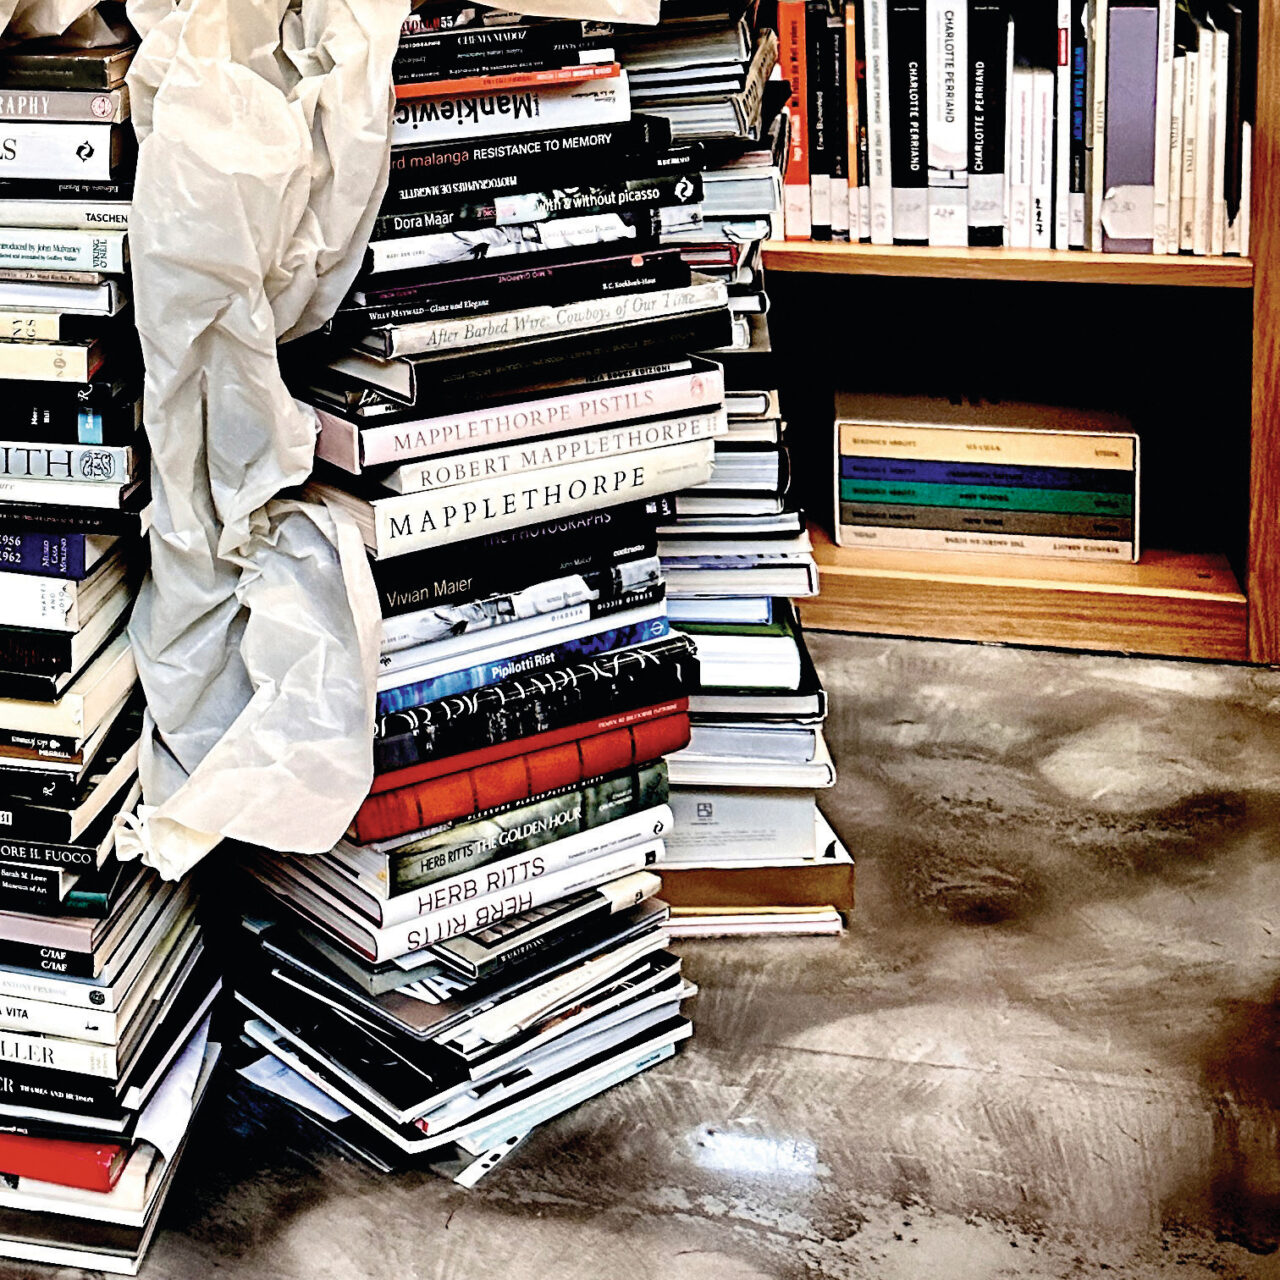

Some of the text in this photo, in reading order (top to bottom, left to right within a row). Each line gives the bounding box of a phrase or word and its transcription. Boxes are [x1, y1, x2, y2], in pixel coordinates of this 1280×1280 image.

[908, 60, 920, 172] CHARLOTTE PERRIAND
[974, 60, 986, 171] CHARLOTTE PERRIAND
[473, 133, 612, 160] RESISTANCE TO MEMORY
[85, 212, 128, 223] TASCHEN
[393, 211, 454, 230] Dora Maar
[393, 390, 655, 452] MAPPLETHORPE PISTILS
[420, 418, 700, 487] ROBERT MAPPLETHORPE
[389, 466, 646, 540] MAPPLETHORPE
[386, 576, 472, 608] Vivian Maier
[491, 651, 556, 679] Pipilotti Rist
[474, 807, 582, 854] THE GOLDEN HOUR
[29, 848, 42, 859] IL
[45, 849, 92, 865] FUOCO
[418, 857, 545, 915] HERB RITTS
[5, 1003, 28, 1019] VITA
